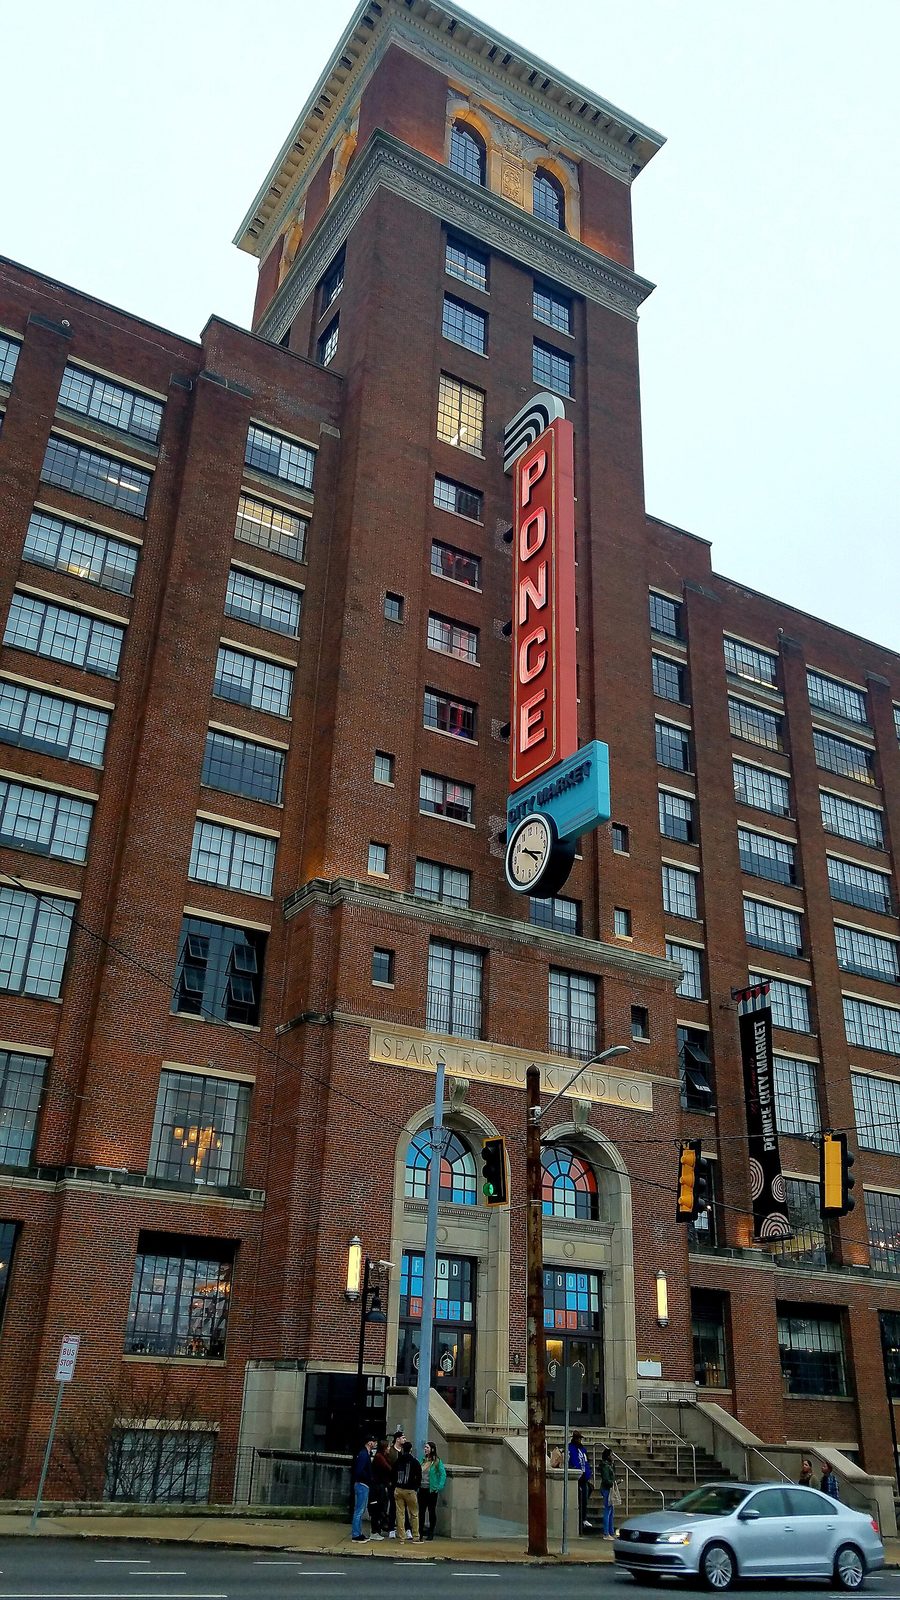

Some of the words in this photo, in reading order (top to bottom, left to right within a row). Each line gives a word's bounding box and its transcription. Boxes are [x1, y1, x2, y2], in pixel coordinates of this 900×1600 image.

[520, 449, 547, 753] PONCE
[508, 795, 536, 824] CITY
[536, 760, 592, 807] MARKET
[754, 1020, 768, 1074] MARKET
[462, 1052, 555, 1089] ROEBUK
[757, 1075, 770, 1105] CITY
[760, 1106, 776, 1152] PONCE
[414, 1259, 458, 1277] FOD
[545, 1273, 585, 1289] FOOD
[60, 1359, 74, 1367] STOP
[62, 1348, 75, 1356] BUS
